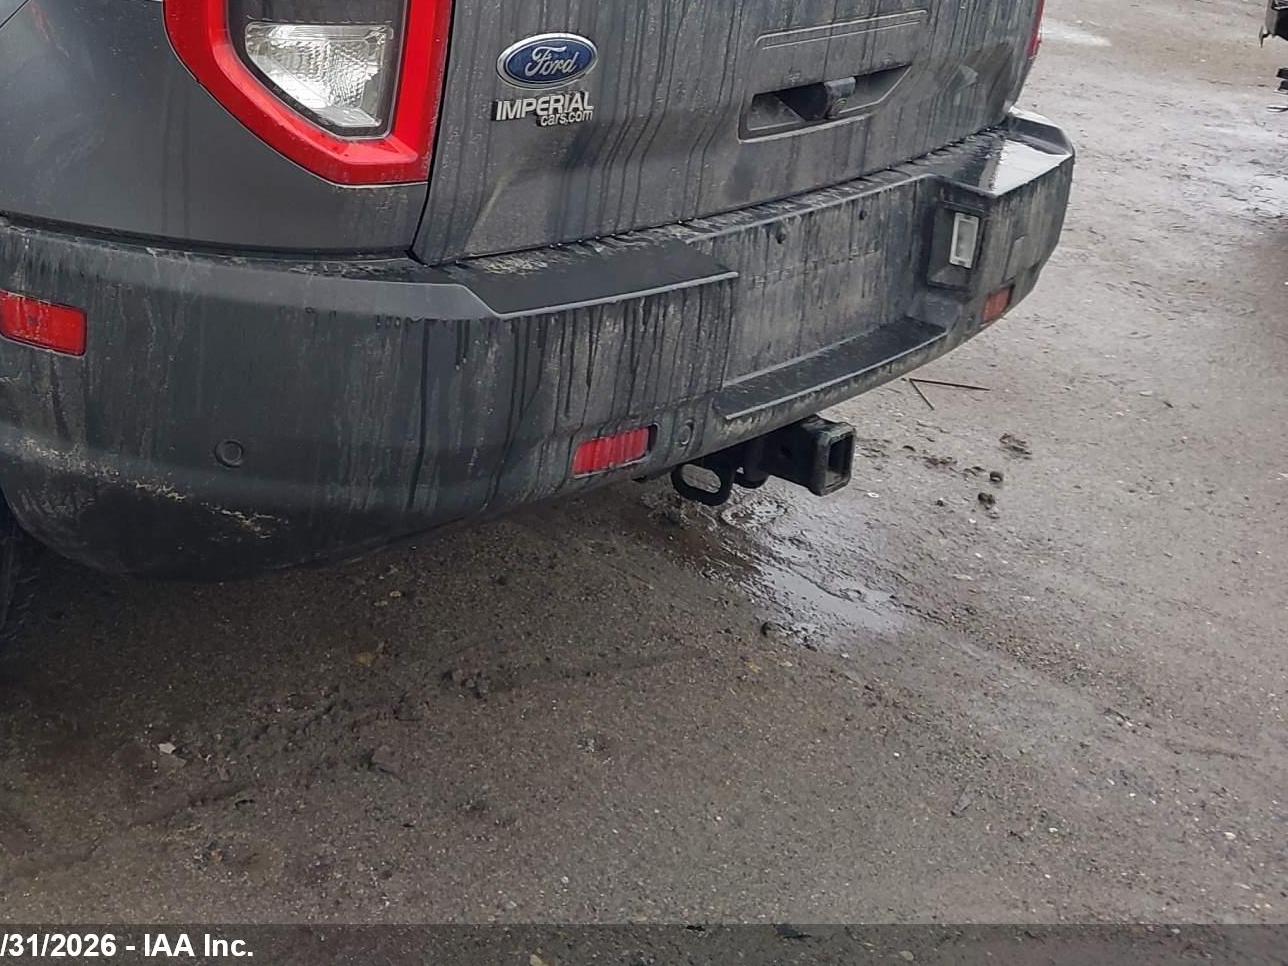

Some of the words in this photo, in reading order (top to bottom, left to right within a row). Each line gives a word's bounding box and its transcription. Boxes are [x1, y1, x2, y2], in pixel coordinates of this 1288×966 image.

[524, 45, 580, 76] Ford
[494, 91, 594, 121] IMPERIAL
[539, 110, 593, 126] cars.com
